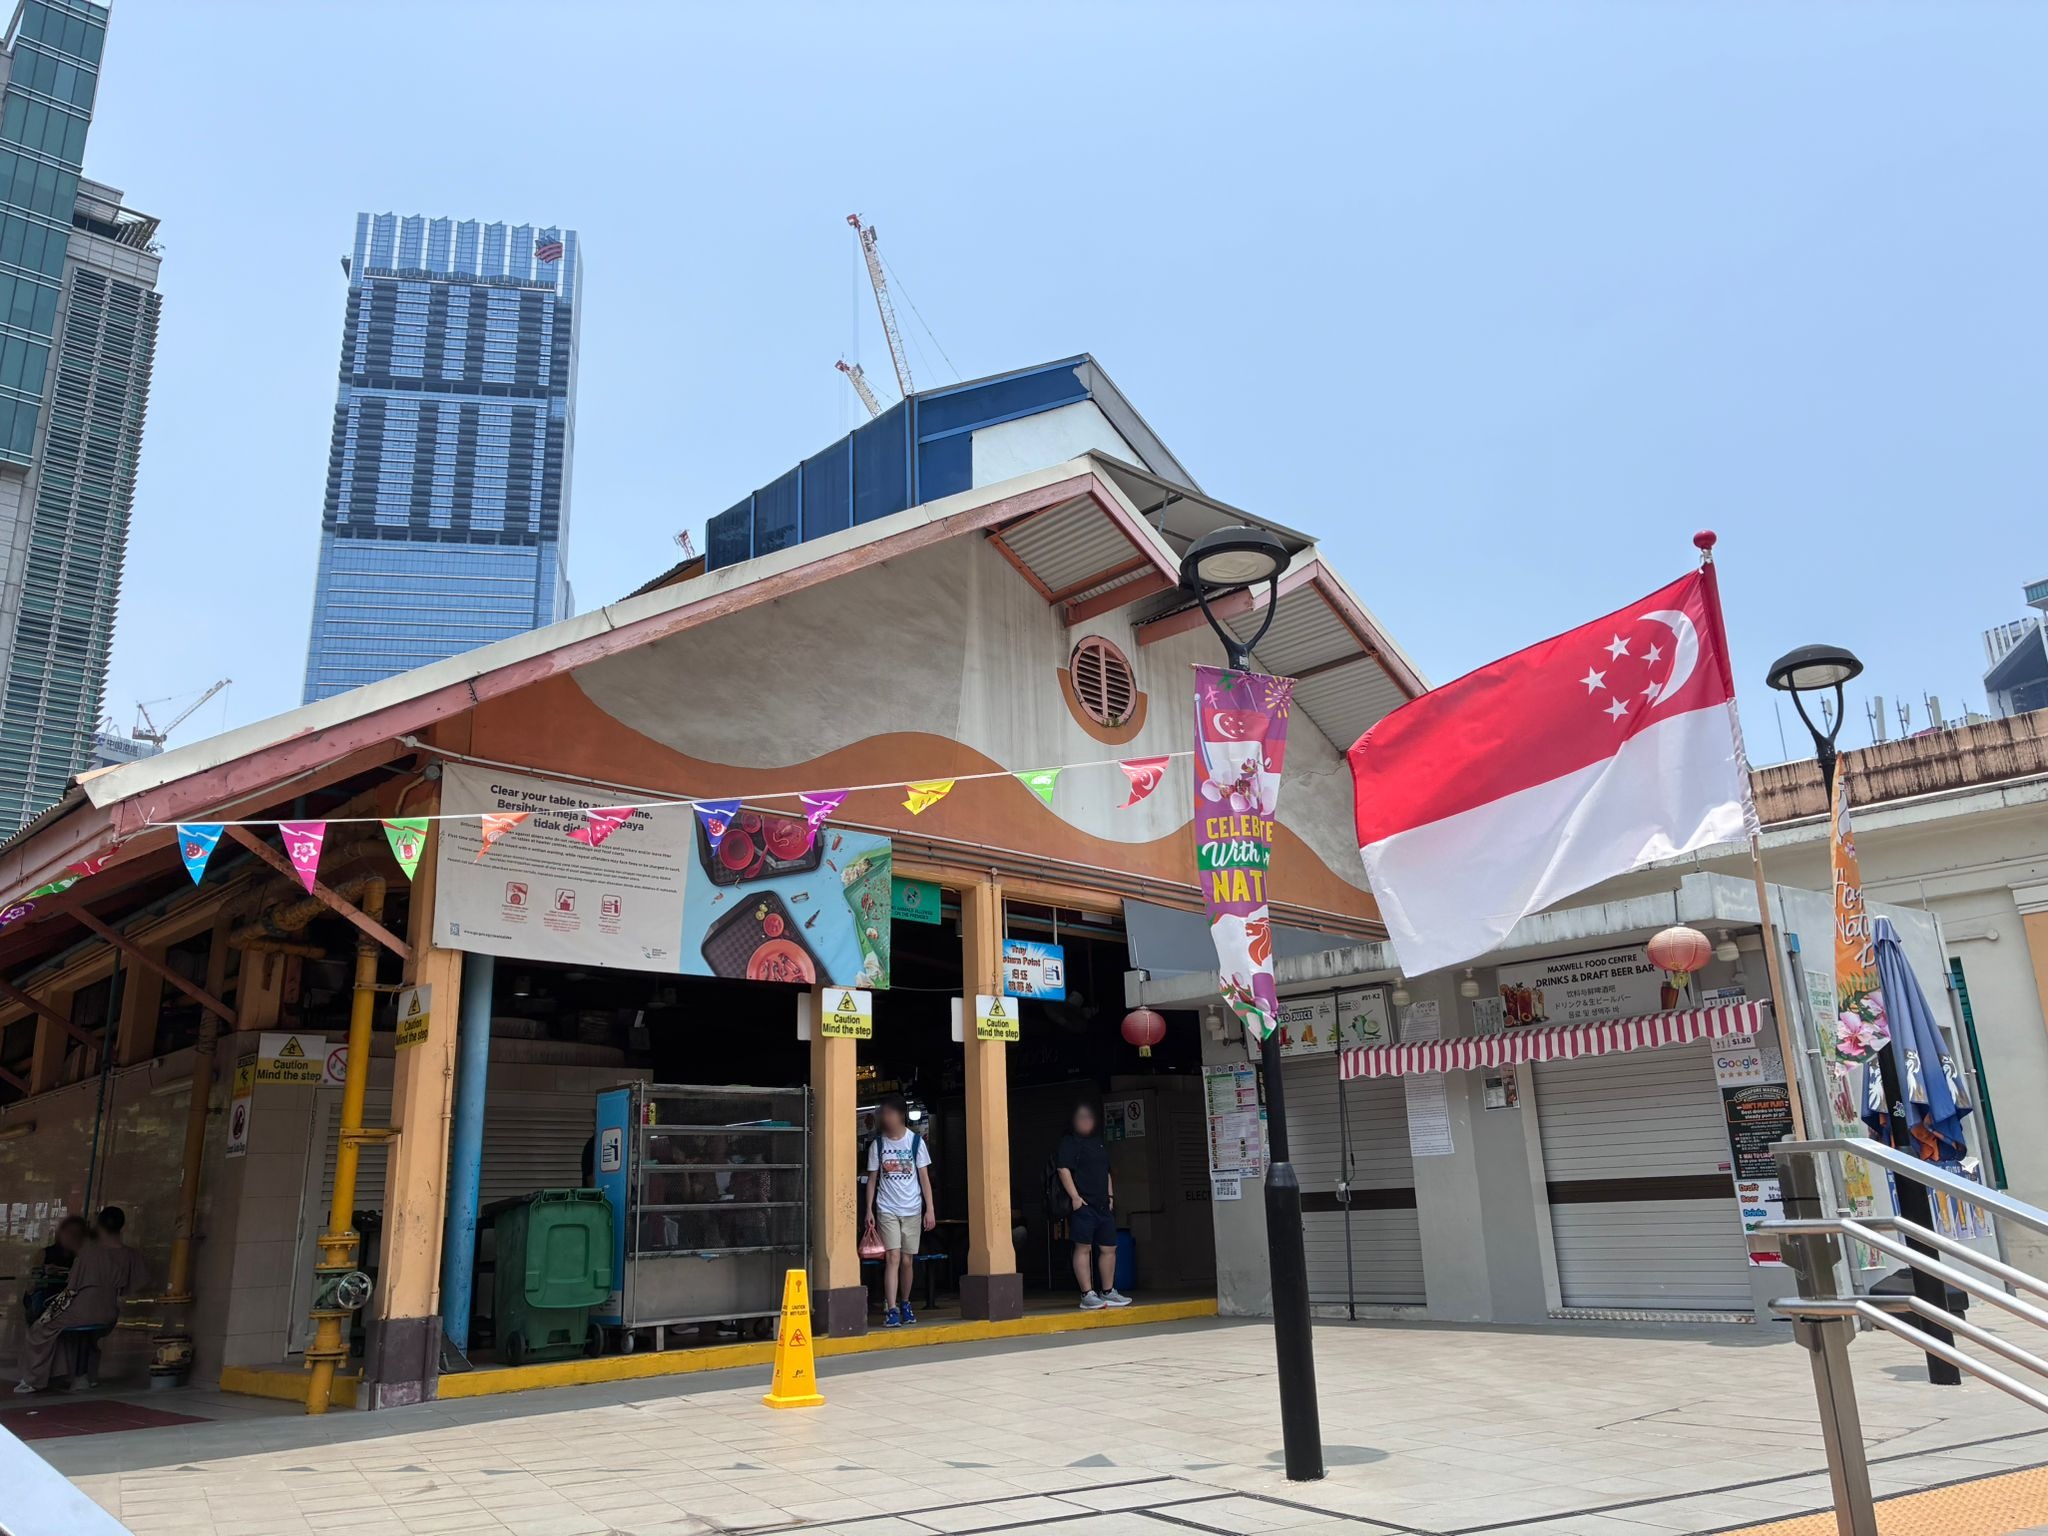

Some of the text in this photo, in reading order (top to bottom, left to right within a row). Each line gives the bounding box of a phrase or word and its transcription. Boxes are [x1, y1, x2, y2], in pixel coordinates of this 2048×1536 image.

[490, 784, 519, 798] Clear
[520, 789, 547, 805] your
[549, 793, 576, 808] table
[578, 798, 590, 809] to
[497, 799, 551, 816] Bersihkan
[552, 809, 579, 823] meja
[533, 817, 561, 832] tidak
[1202, 839, 1260, 867] With
[1212, 870, 1263, 903] NAT
[1010, 944, 1027, 957] Tray
[1003, 955, 1042, 967] eturn Point
[1547, 953, 1637, 973] MAXWELL FOOD CENTRE
[1535, 962, 1655, 988] DRINKS & DRAFT BEER BAR
[834, 1013, 861, 1025] Caution
[1292, 1010, 1313, 1021] JUICE
[404, 1019, 423, 1031] Caution
[986, 1018, 1009, 1028] Caution
[822, 1024, 871, 1036] Mind the step
[977, 1027, 1019, 1039] Mind the step
[396, 1033, 409, 1046] Mind
[416, 1029, 429, 1042] step
[1732, 1036, 1752, 1045] $1.80
[273, 1060, 309, 1070] Caution
[1717, 1056, 1759, 1070] Google
[256, 1070, 321, 1083] Mind the step
[1738, 1183, 1759, 1192] Draft
[1740, 1194, 1759, 1203] Beer
[1743, 1208, 1767, 1218] Drinks
